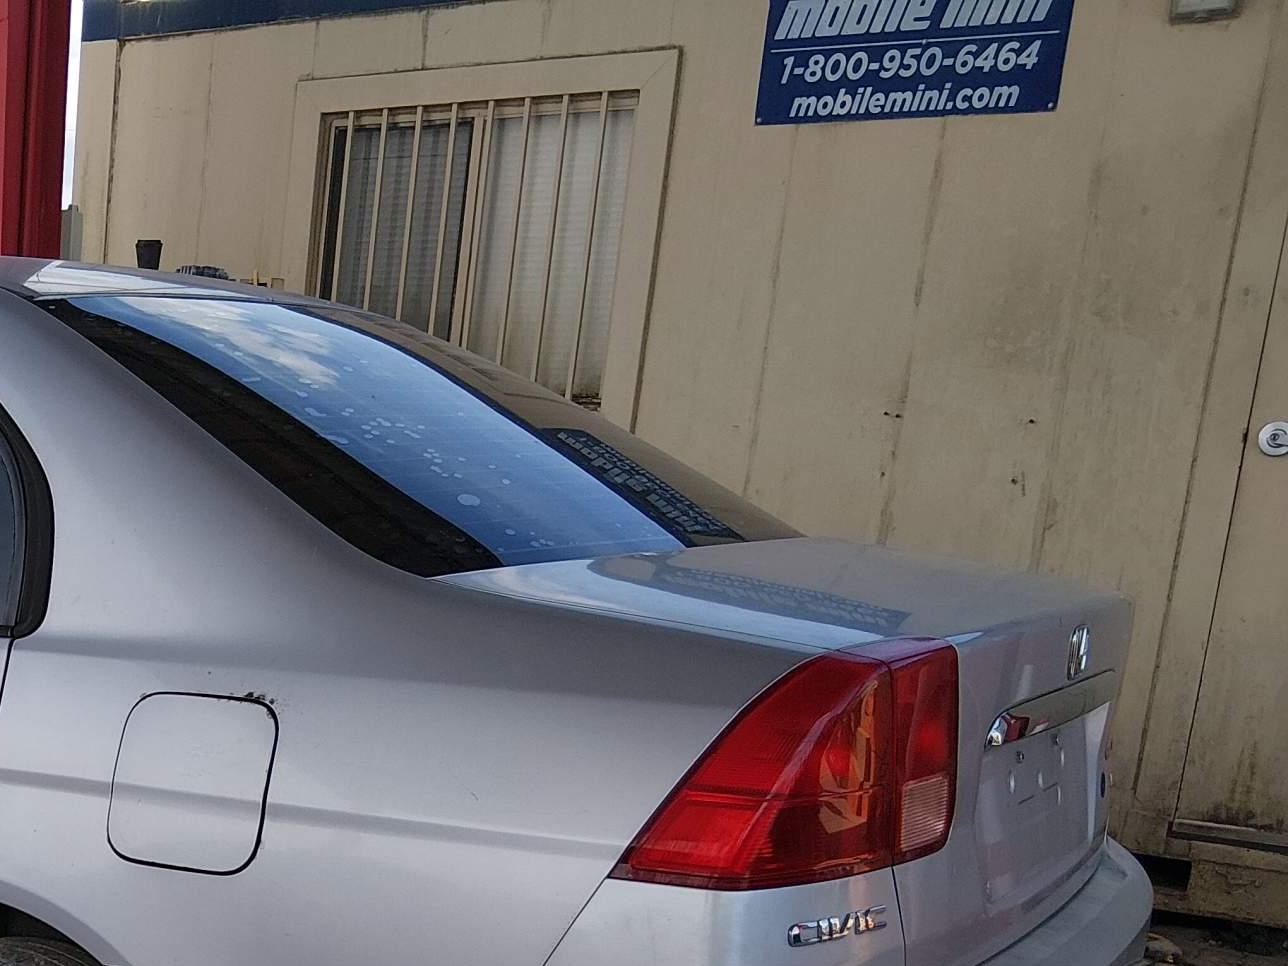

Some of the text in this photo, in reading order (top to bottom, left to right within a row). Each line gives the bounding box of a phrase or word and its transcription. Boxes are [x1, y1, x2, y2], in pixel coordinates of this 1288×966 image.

[774, 0, 935, 40] mobile
[780, 40, 1041, 84] 1-800-950-6464
[789, 85, 1020, 117] mobilemini.com
[787, 904, 887, 948] CIVIC
